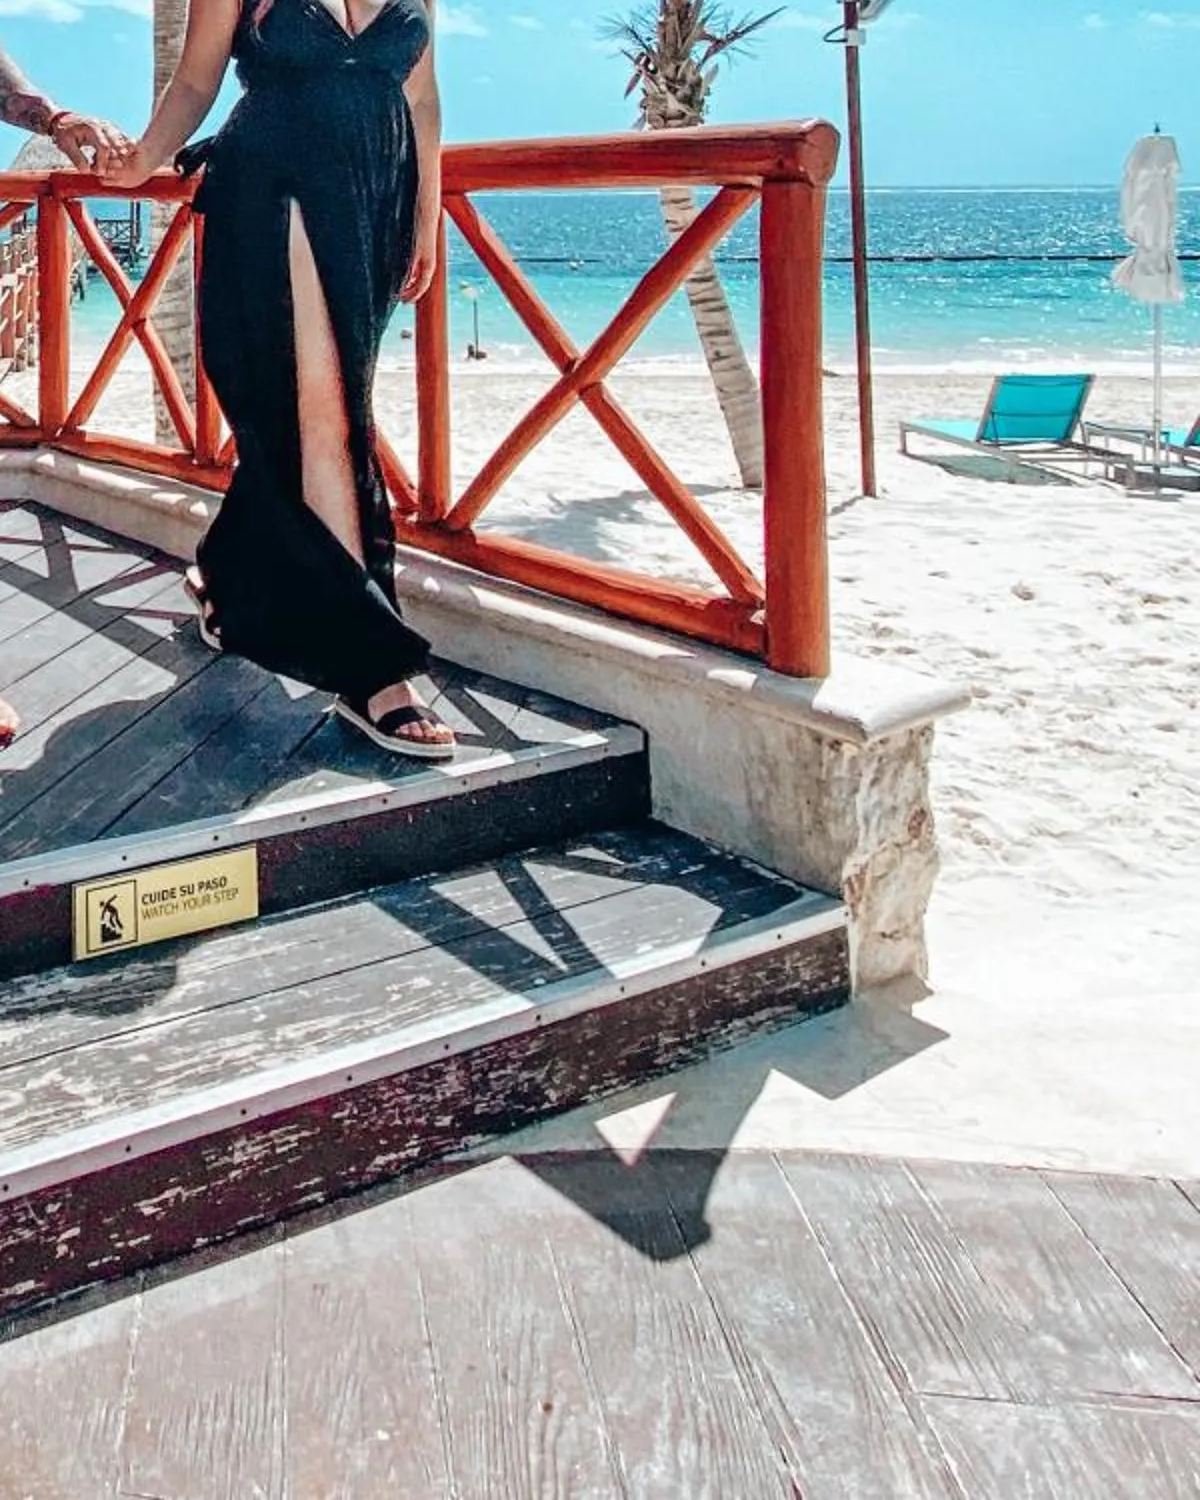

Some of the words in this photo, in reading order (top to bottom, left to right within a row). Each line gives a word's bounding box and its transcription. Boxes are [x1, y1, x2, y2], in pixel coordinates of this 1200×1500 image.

[141, 887, 177, 905] CUIDE
[179, 883, 195, 897] SU
[198, 876, 227, 893] PASO
[141, 902, 179, 920] WATCH
[182, 893, 211, 911] YOUR
[213, 887, 239, 904] STEP
